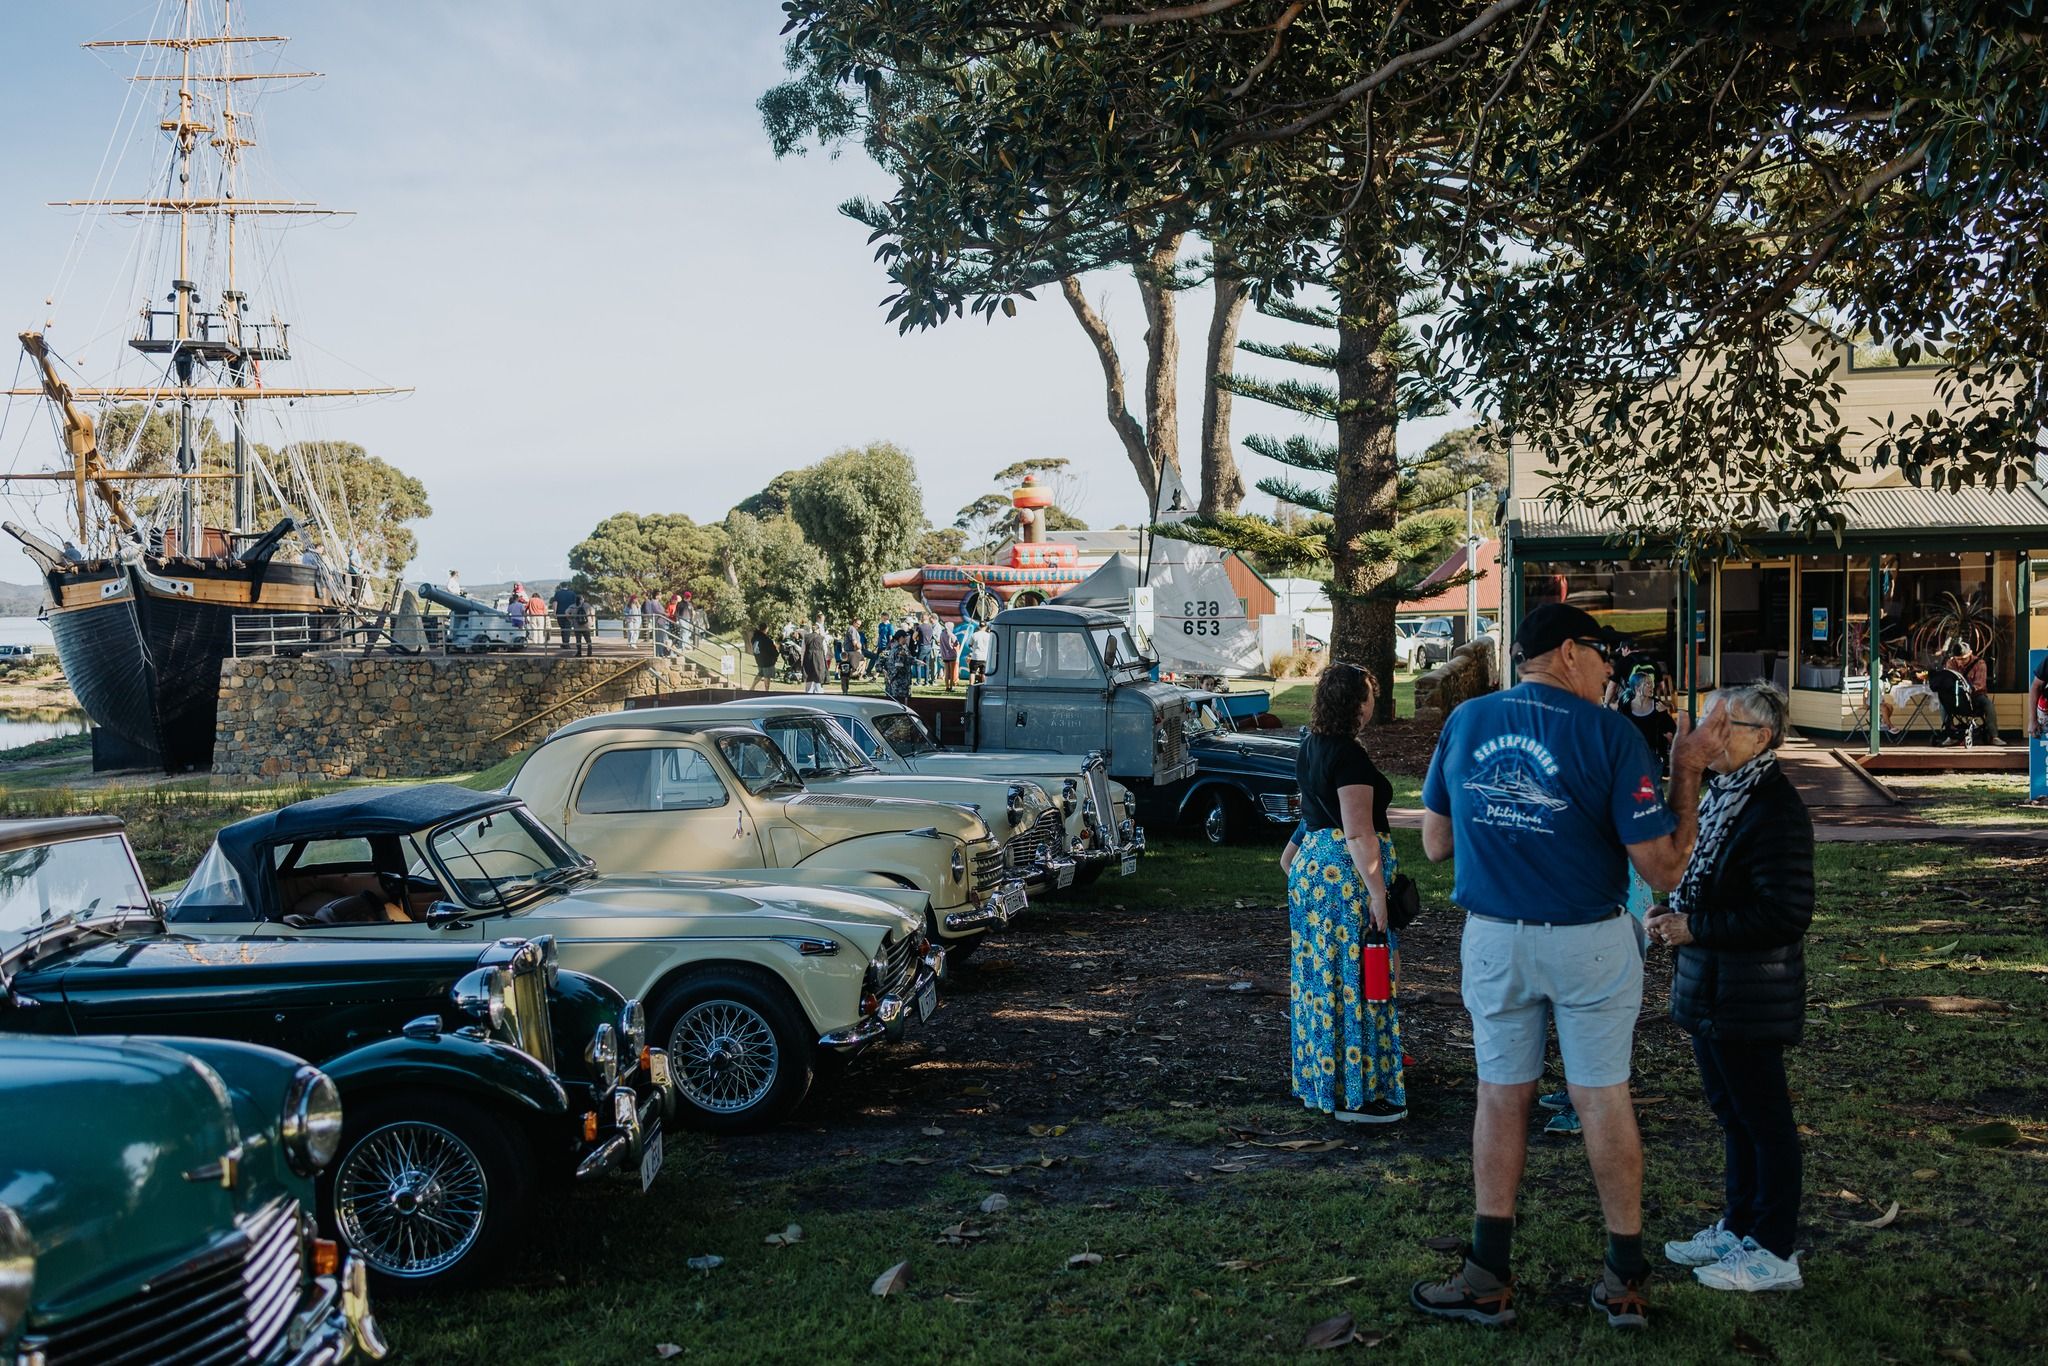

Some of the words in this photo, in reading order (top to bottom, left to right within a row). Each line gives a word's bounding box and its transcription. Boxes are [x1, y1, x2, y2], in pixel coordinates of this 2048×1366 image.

[1183, 620, 1220, 636] 653
[1473, 740, 1497, 761] SEA
[1498, 735, 1558, 775] EXPLORERS
[1486, 804, 1542, 824] Philippines
[1747, 1263, 1769, 1279] N
